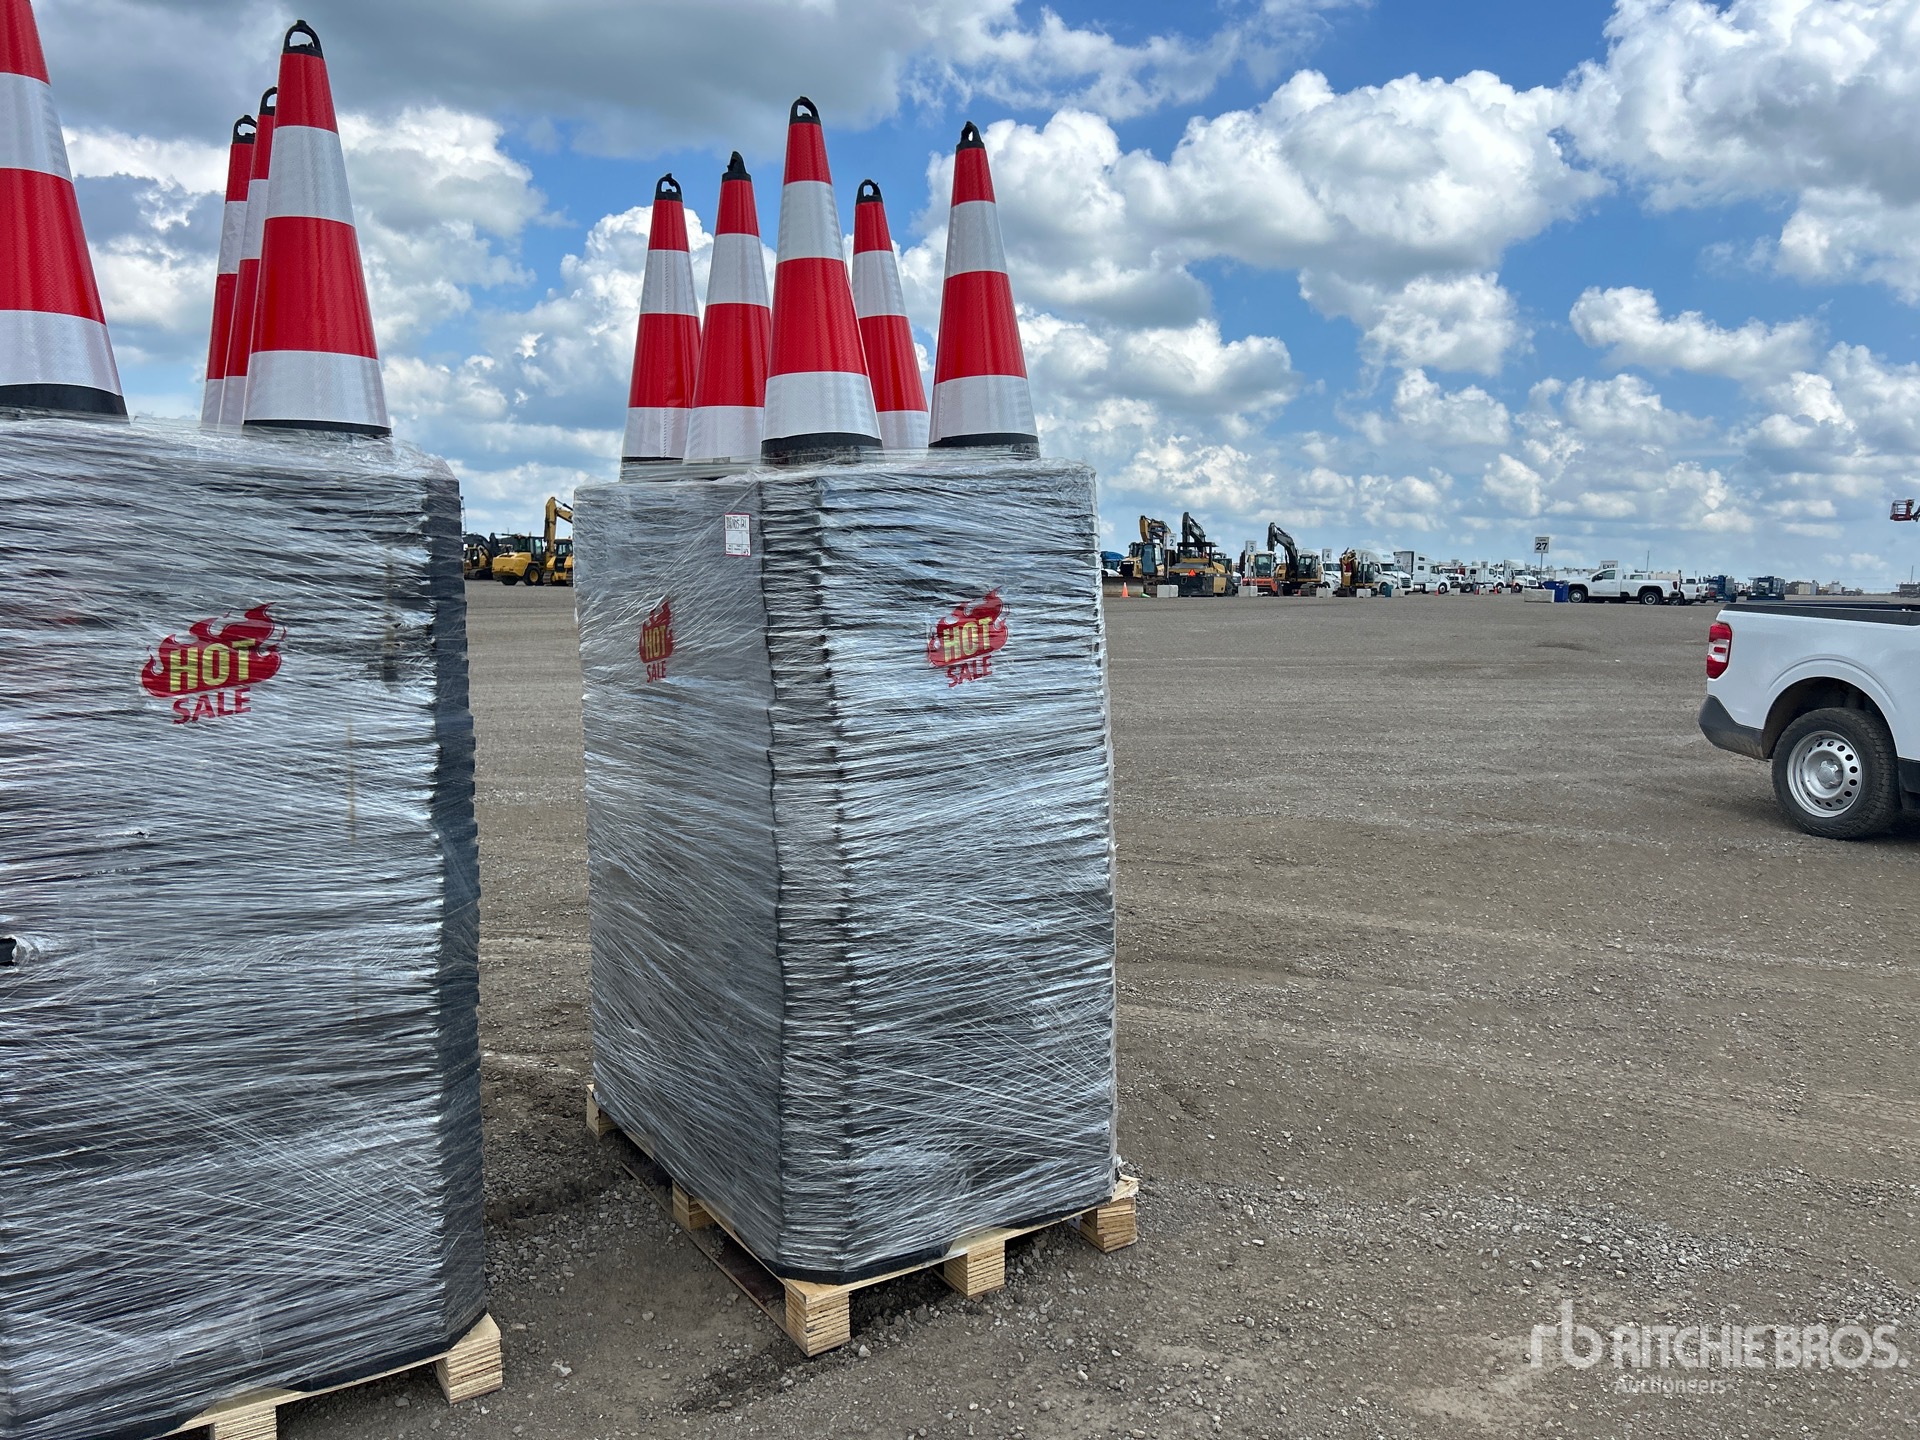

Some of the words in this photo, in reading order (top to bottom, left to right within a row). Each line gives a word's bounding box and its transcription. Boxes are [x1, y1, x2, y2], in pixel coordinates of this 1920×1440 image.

[1169, 538, 1174, 547] 2
[1249, 545, 1254, 553] 3
[1535, 542, 1548, 551] 27
[645, 625, 666, 660] HOT
[943, 616, 993, 662] HOT
[169, 638, 256, 692] HOT
[646, 660, 667, 683] SALE
[946, 655, 993, 688] SALE
[172, 687, 252, 724] SALE
